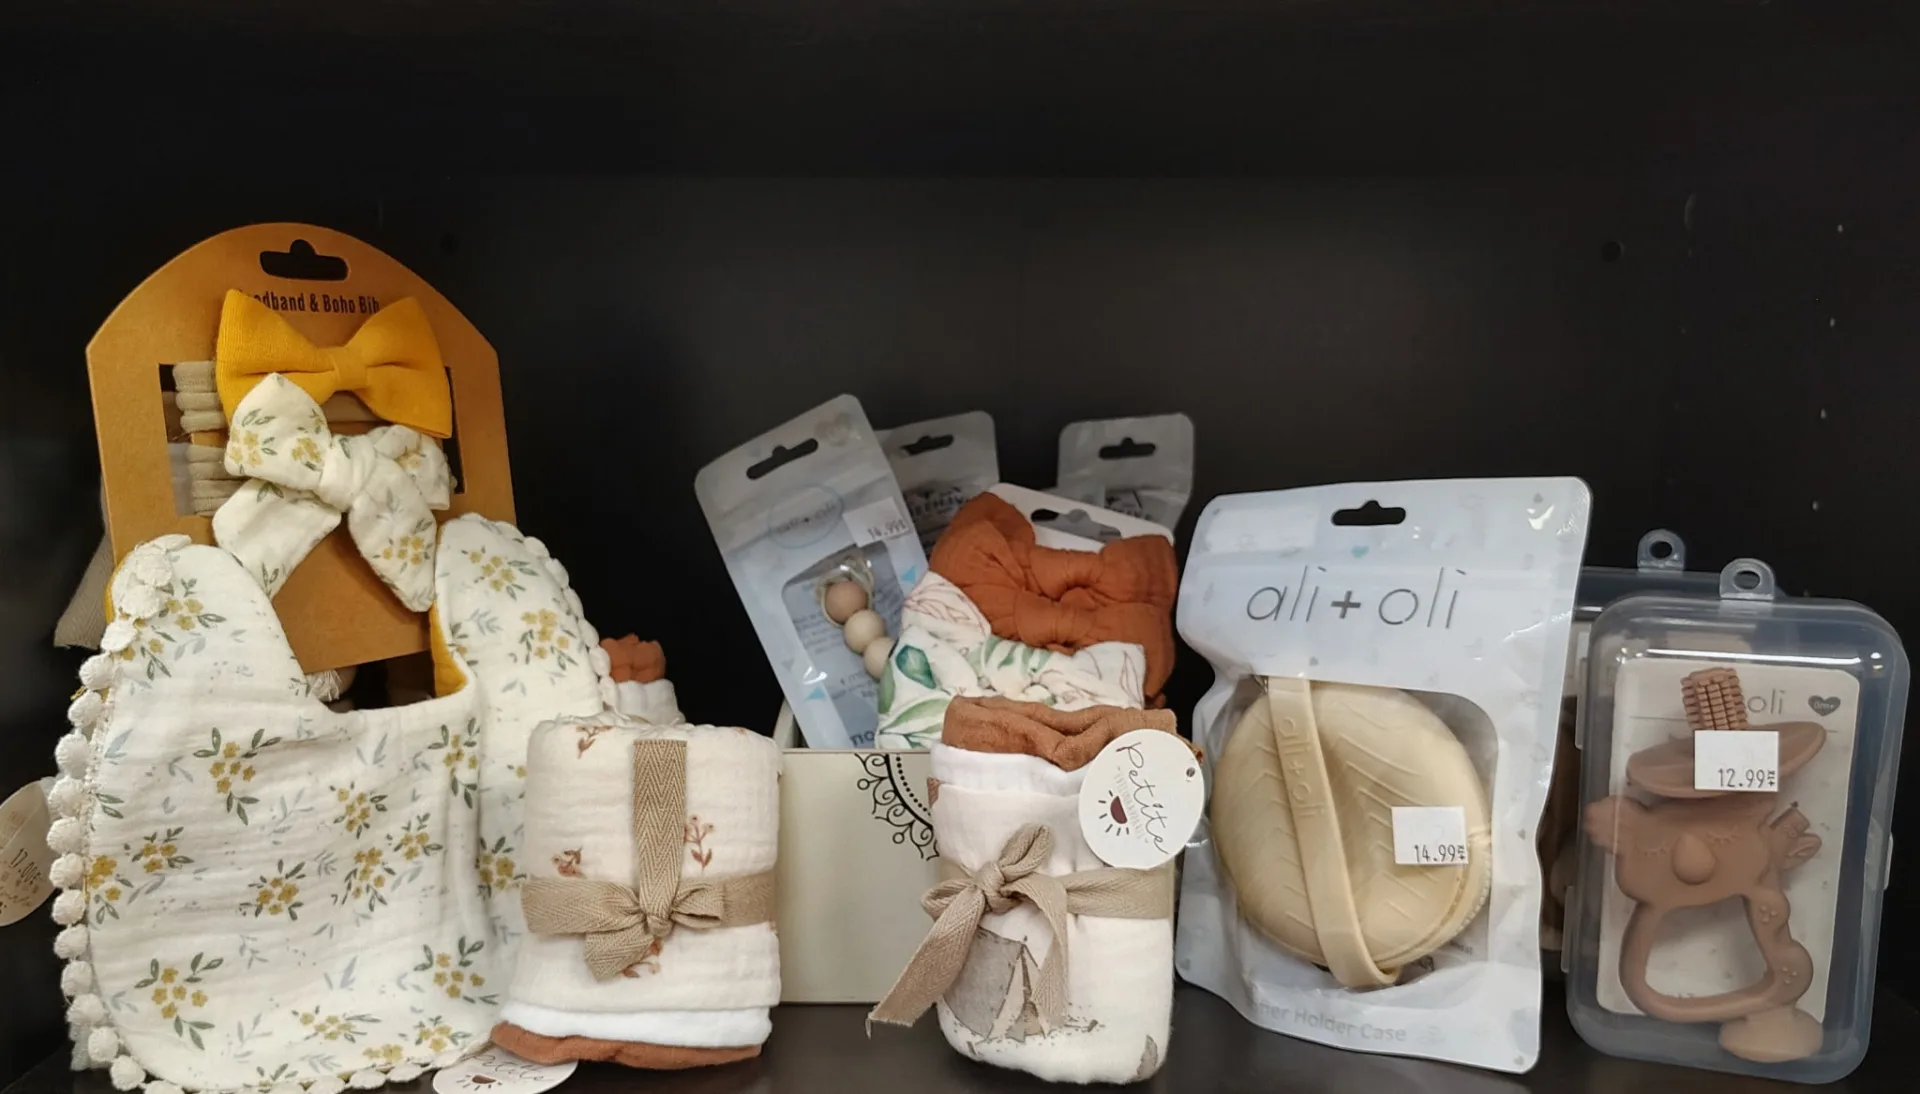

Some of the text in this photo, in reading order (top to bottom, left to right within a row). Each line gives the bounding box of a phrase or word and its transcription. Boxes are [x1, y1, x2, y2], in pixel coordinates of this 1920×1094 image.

[309, 293, 319, 313] &
[323, 294, 356, 314] Boho
[1331, 590, 1361, 619] +
[1747, 689, 1787, 716] oli
[1717, 768, 1765, 788] 12.99
[1115, 741, 1170, 855] Petite
[1413, 844, 1457, 863] 14.99
[1294, 1007, 1354, 1034] Holder
[1360, 1023, 1407, 1042] Case
